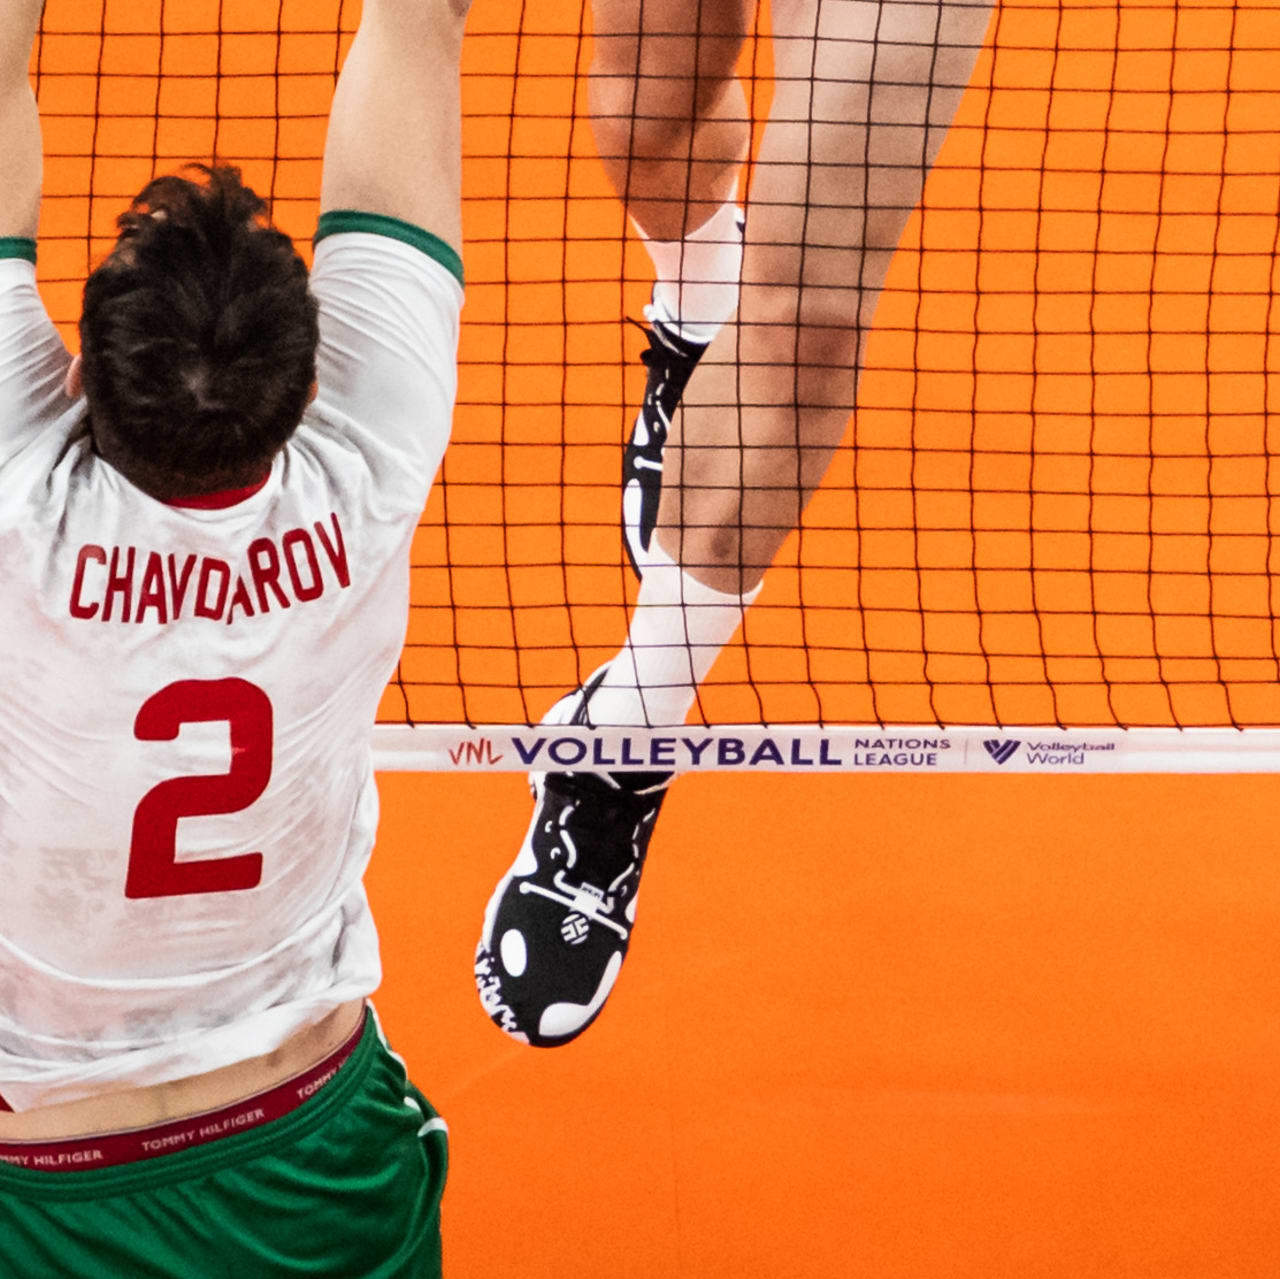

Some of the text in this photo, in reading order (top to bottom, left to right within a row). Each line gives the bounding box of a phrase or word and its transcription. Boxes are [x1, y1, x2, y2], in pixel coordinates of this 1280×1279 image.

[69, 512, 351, 624] CHAVDAROV
[448, 737, 843, 766] VNL VOLLEYBALL
[854, 738, 952, 750] NATIONS
[1026, 742, 1116, 753] Volleyball
[853, 752, 938, 765] LEAGUE
[1026, 752, 1085, 765] World
[125, 677, 273, 899] 2
[141, 1108, 265, 1152] TOMMY HILFIGER
[33, 1149, 103, 1166] HILFIGER
